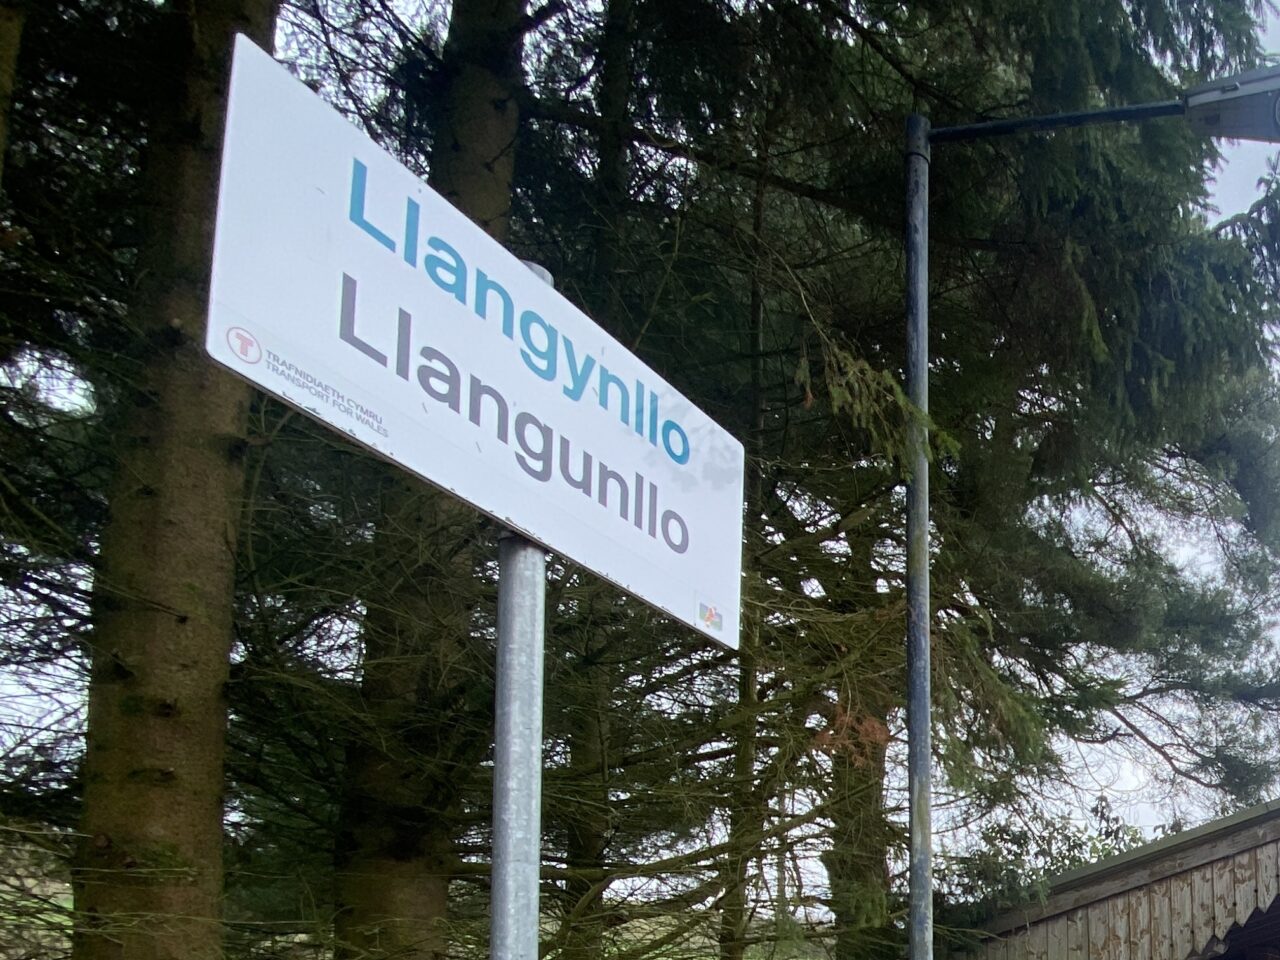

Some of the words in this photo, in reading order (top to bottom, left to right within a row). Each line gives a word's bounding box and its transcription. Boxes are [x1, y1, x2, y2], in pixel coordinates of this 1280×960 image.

[266, 350, 345, 400] TRAFNIDIAETH
[347, 398, 383, 425] CYMRU
[266, 360, 329, 404] TRANSPORT
[332, 399, 354, 419] FOR
[356, 413, 389, 438] WALES
[350, 157, 690, 465] Llangynllo
[339, 272, 690, 554] Llangunllo
